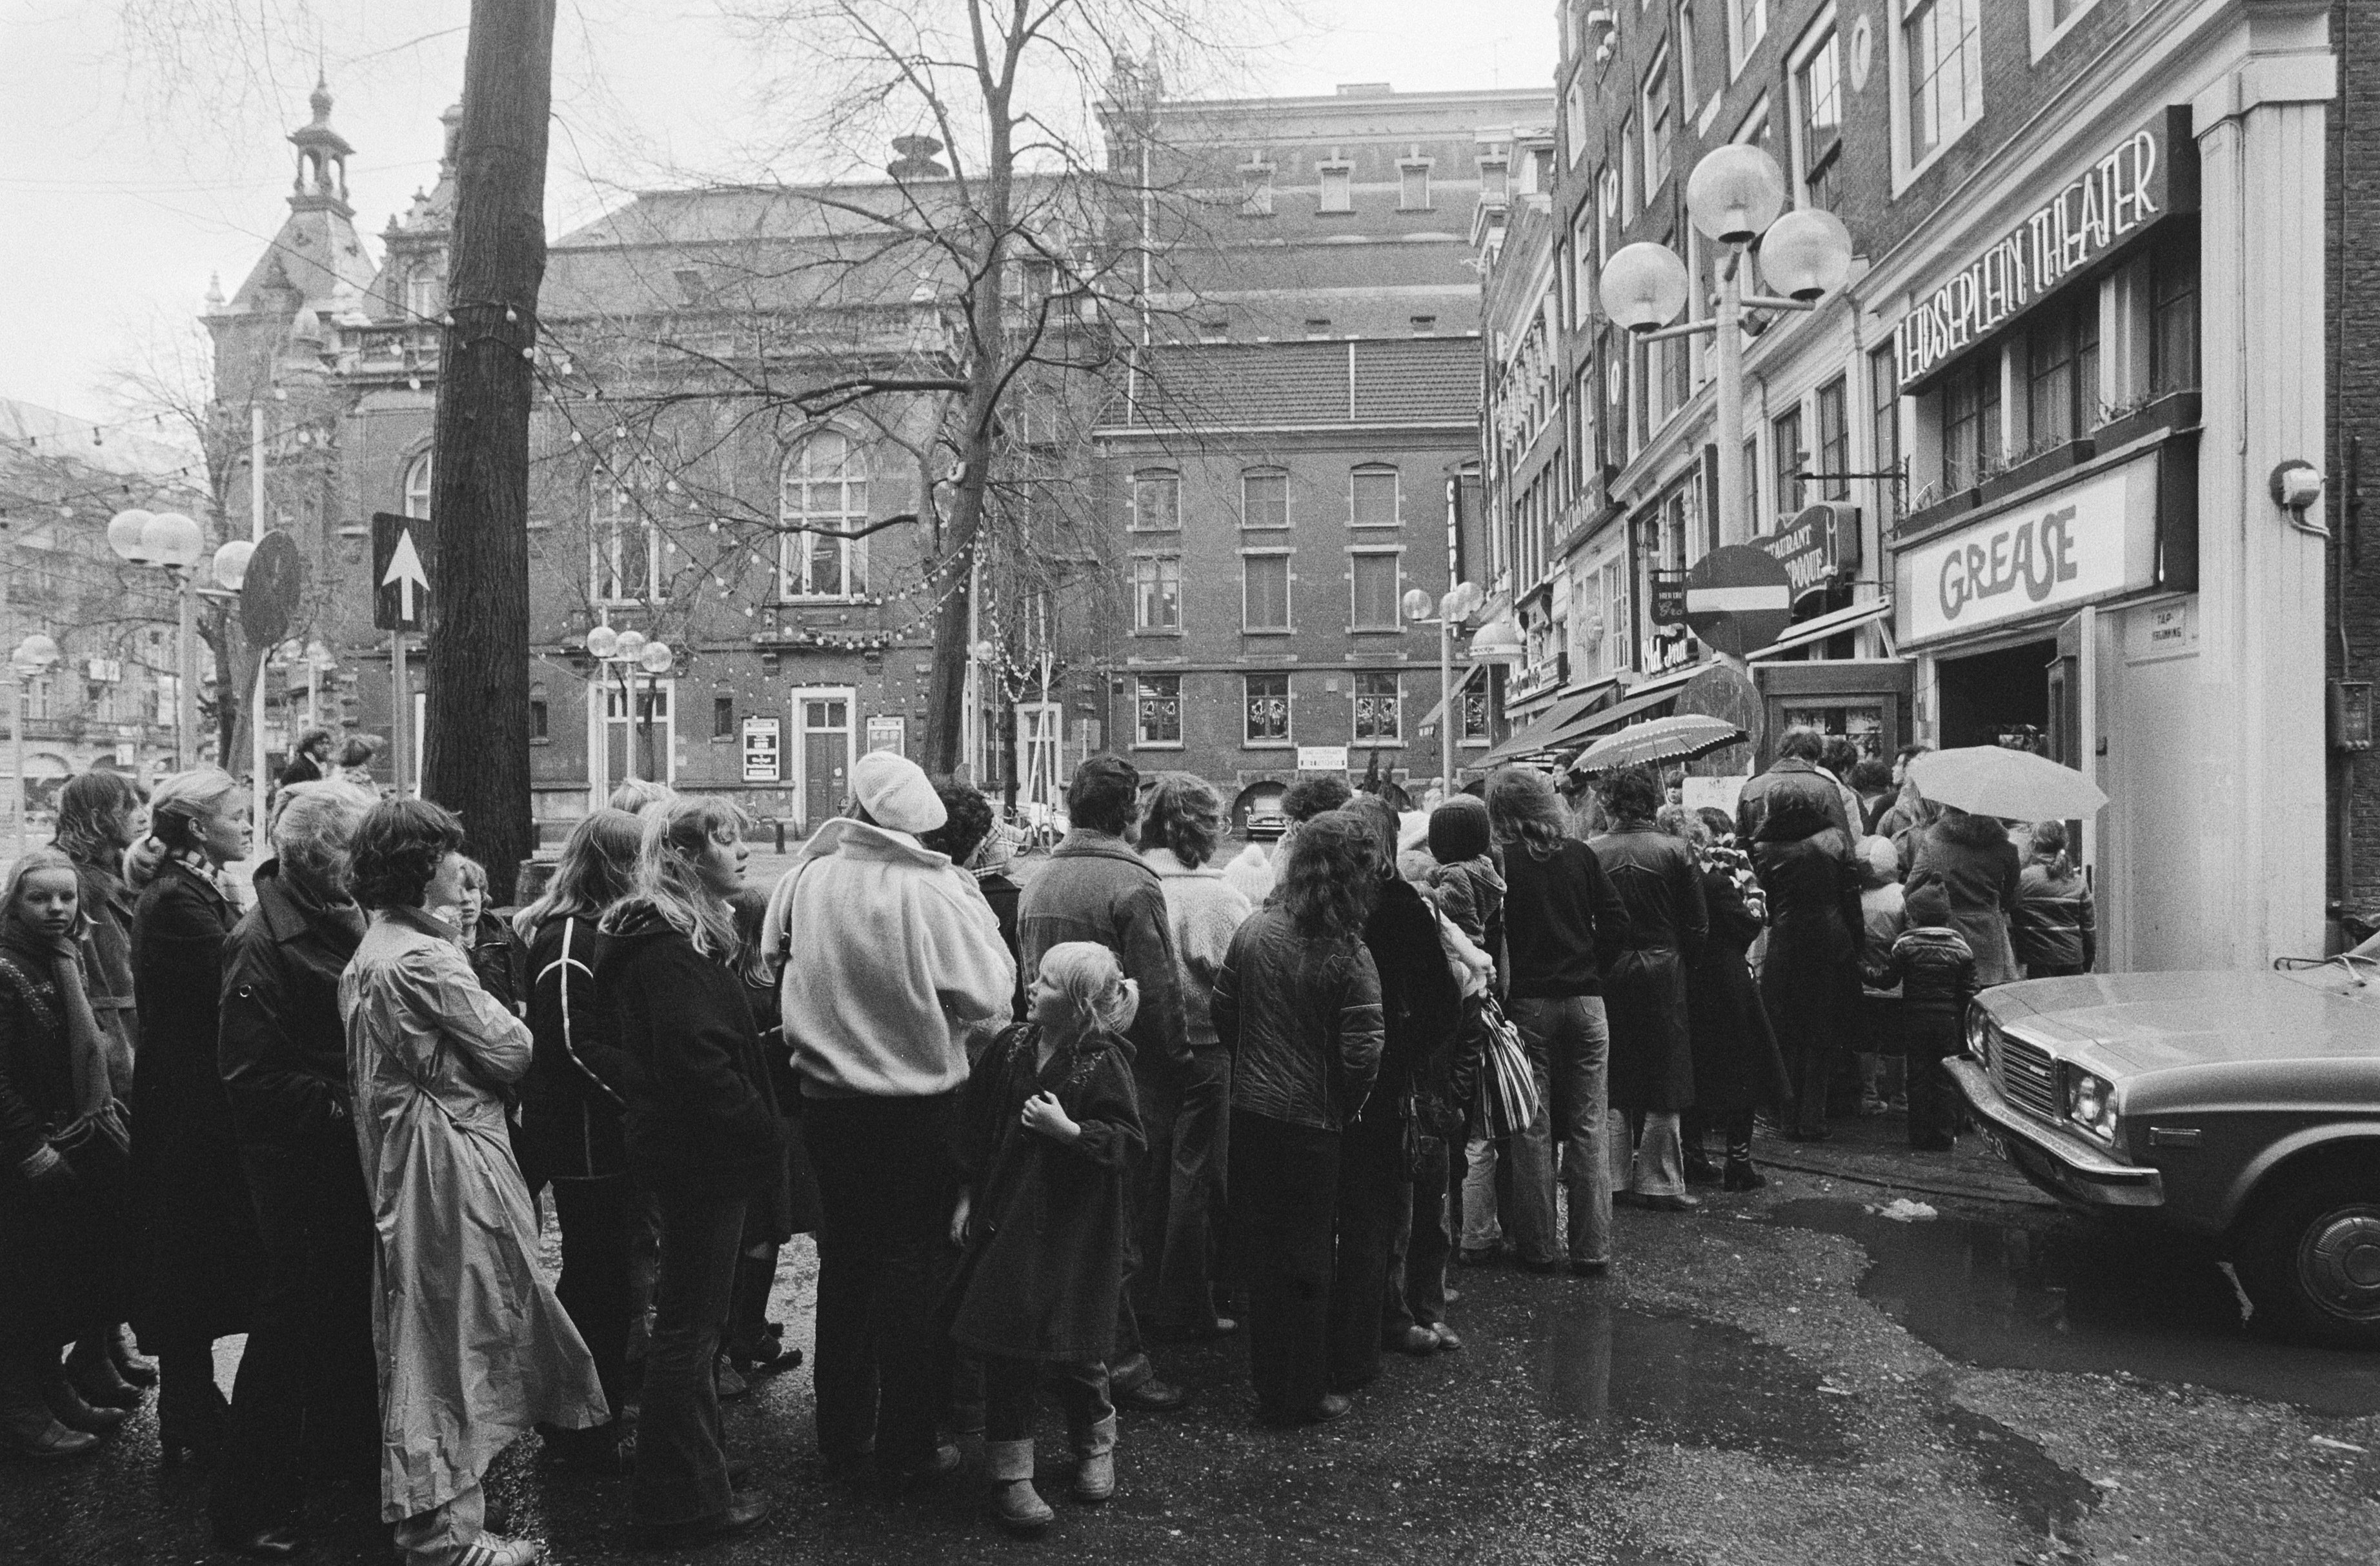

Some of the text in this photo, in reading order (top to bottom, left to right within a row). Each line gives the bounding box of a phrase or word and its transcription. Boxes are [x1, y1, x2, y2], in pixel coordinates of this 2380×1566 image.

[1895, 130, 2159, 386] LEIDSEPLEIN THEATER
[1939, 505, 2077, 620] GREASE
